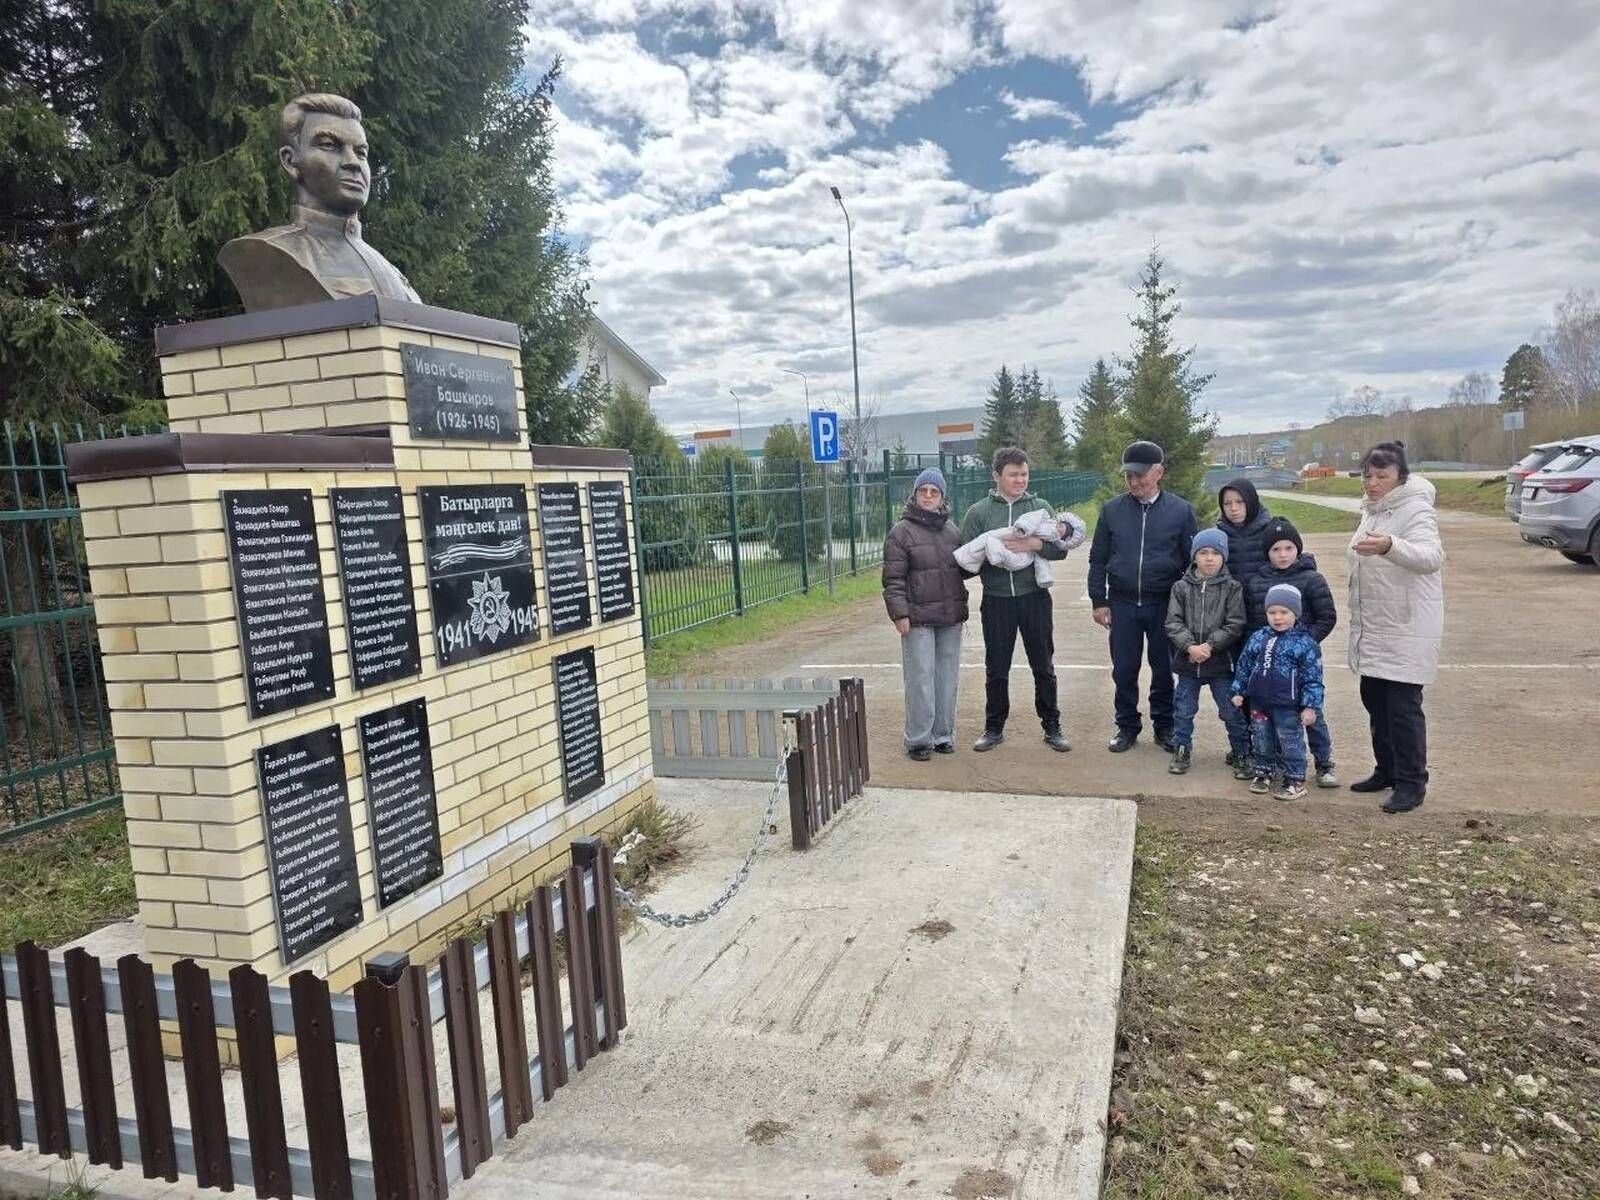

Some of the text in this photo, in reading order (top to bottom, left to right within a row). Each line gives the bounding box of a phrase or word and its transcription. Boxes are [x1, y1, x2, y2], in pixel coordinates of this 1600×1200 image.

[414, 358, 446, 378] Иван
[437, 385, 494, 406] Башкиров
[436, 410, 500, 433] (1926-1945)
[818, 417, 834, 457] P
[439, 494, 514, 515] Батырларга
[436, 516, 522, 541] мәңгелек дан!
[510, 604, 540, 635] 1945
[437, 621, 472, 654] 1941
